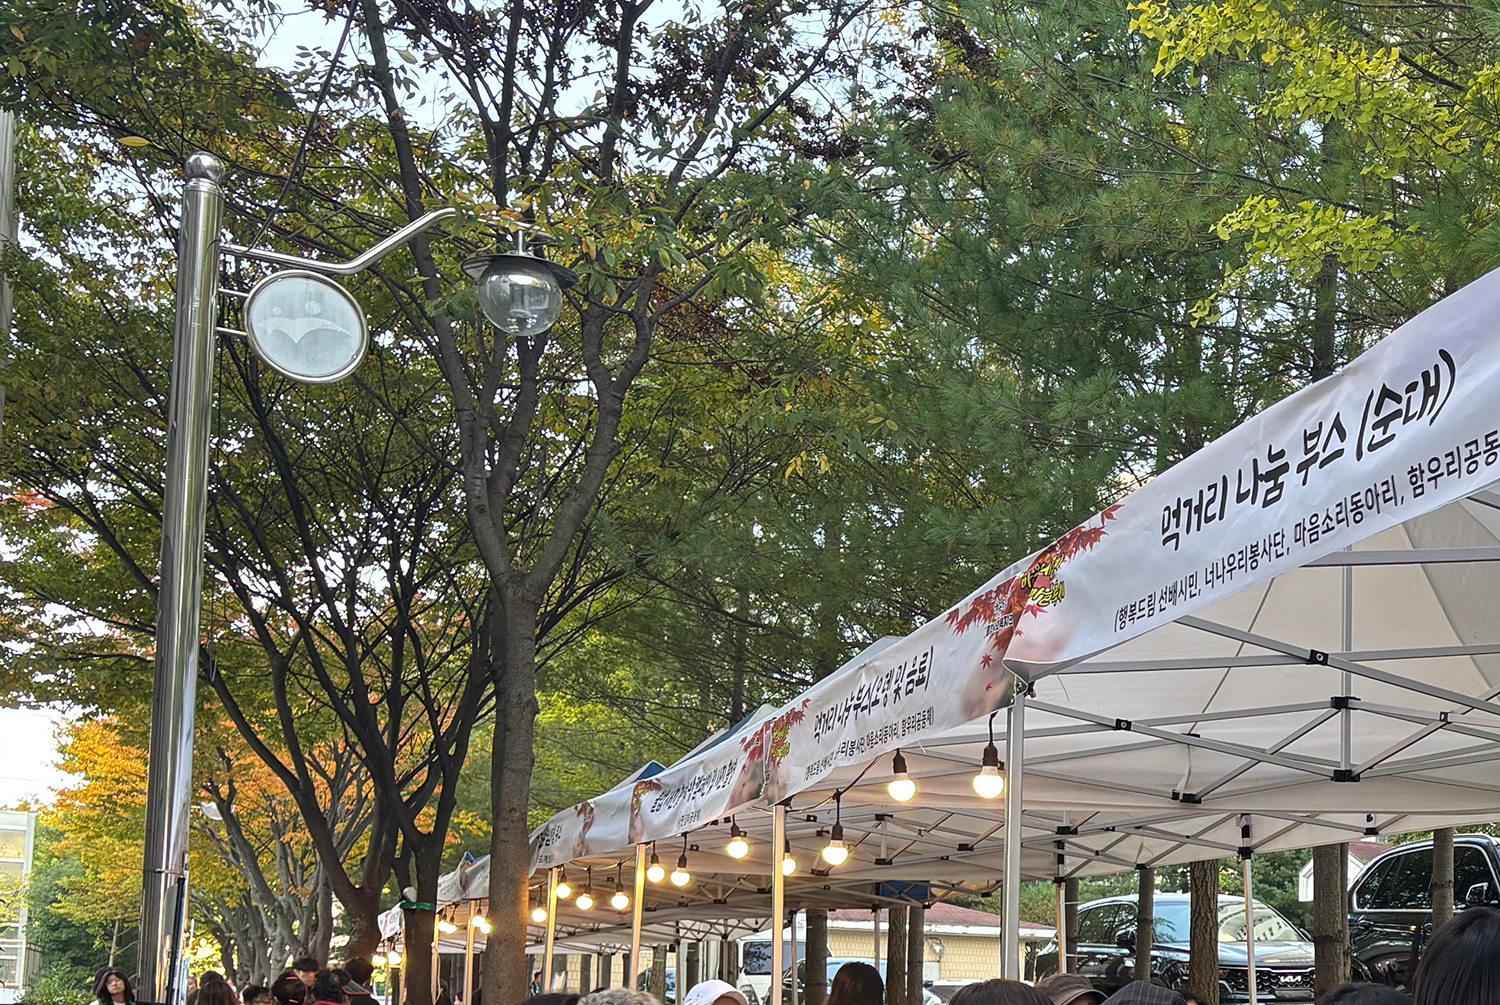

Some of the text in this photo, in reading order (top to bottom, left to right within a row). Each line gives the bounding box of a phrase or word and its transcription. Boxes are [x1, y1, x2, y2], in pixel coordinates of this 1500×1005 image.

[1113, 597, 1158, 634] (행복드림
[1157, 570, 1203, 614] 선배시민,
[1204, 531, 1291, 591] 너나우리봉사단,
[1292, 474, 1406, 549] 마음소리동아리,
[1160, 474, 1230, 552] 먹거리
[1236, 443, 1290, 510] 나눔
